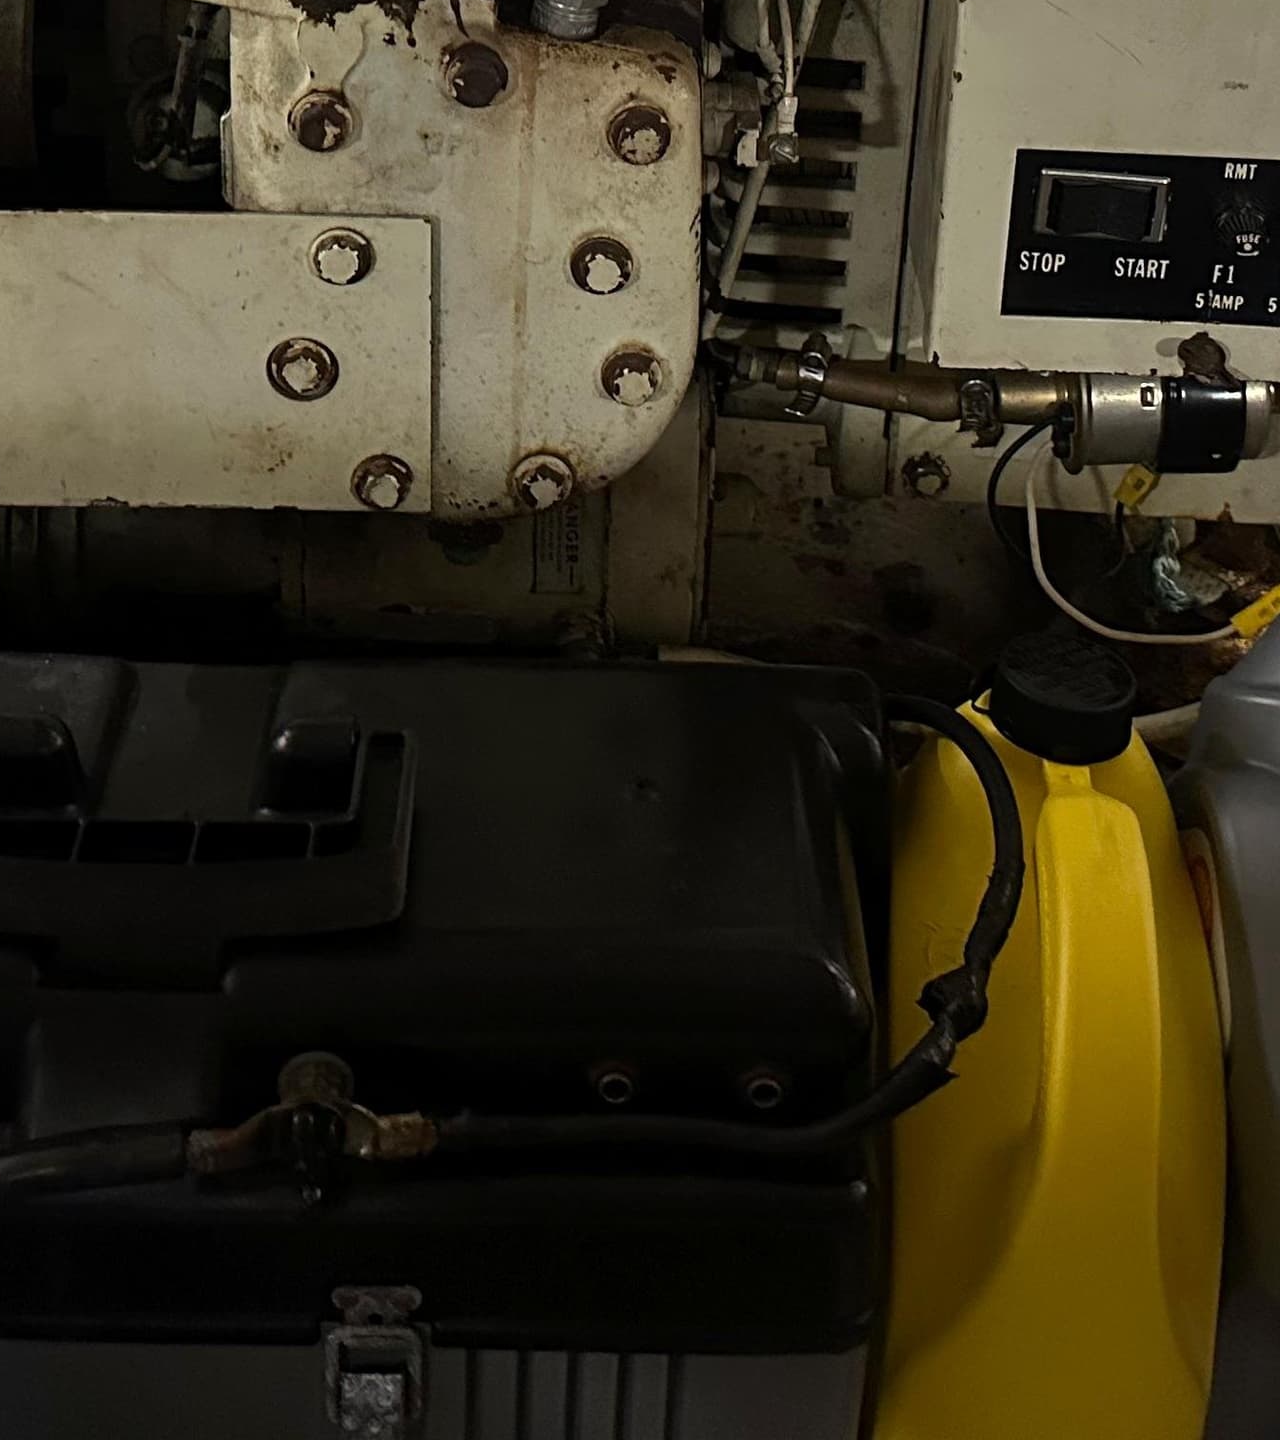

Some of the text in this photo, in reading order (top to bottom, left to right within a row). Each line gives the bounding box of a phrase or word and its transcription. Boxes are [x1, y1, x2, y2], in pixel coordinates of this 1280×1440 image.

[1224, 163, 1258, 181] RMT
[1236, 233, 1261, 244] FUSE
[1020, 251, 1170, 280] STOP START
[1195, 293, 1244, 312] 5 AMP
[1268, 297, 1278, 313] 5
[565, 503, 579, 563] ANGER
